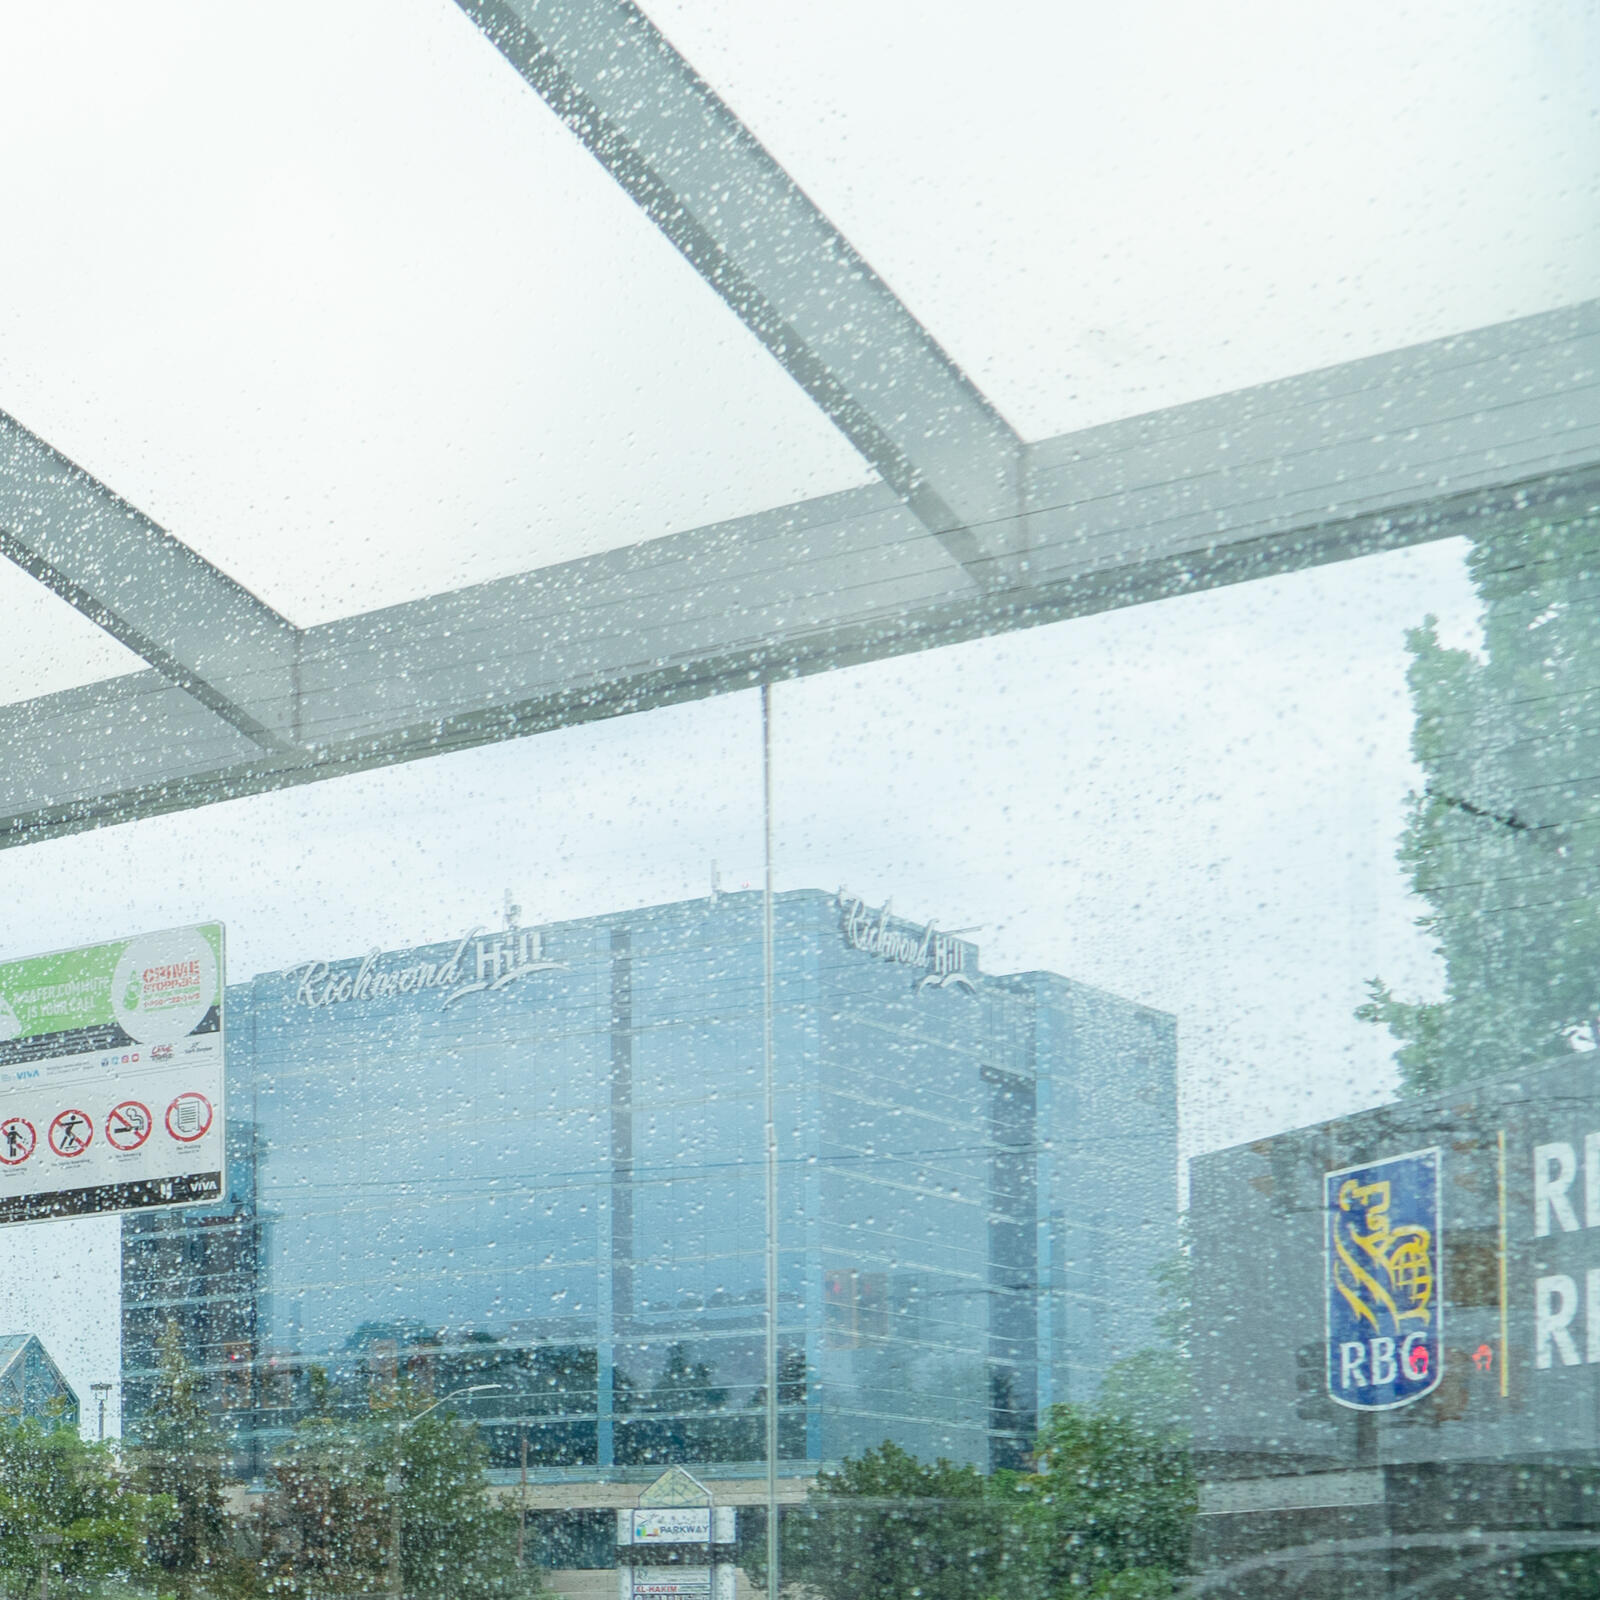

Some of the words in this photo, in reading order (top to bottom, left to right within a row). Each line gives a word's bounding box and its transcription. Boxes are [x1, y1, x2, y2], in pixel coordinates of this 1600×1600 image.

[841, 893, 939, 969] Richmond
[934, 934, 966, 976] Hill
[143, 960, 200, 984] CRIME
[281, 926, 487, 1008] Richmond
[476, 931, 545, 980] Hill
[68, 996, 96, 1012] CALL
[16, 1070, 40, 1081] VIVA
[190, 1180, 217, 1193] VIVA
[1339, 1331, 1430, 1389] RBC
[659, 1525, 709, 1535] PARKWAY
[636, 1585, 677, 1593] AL-HAKIM
